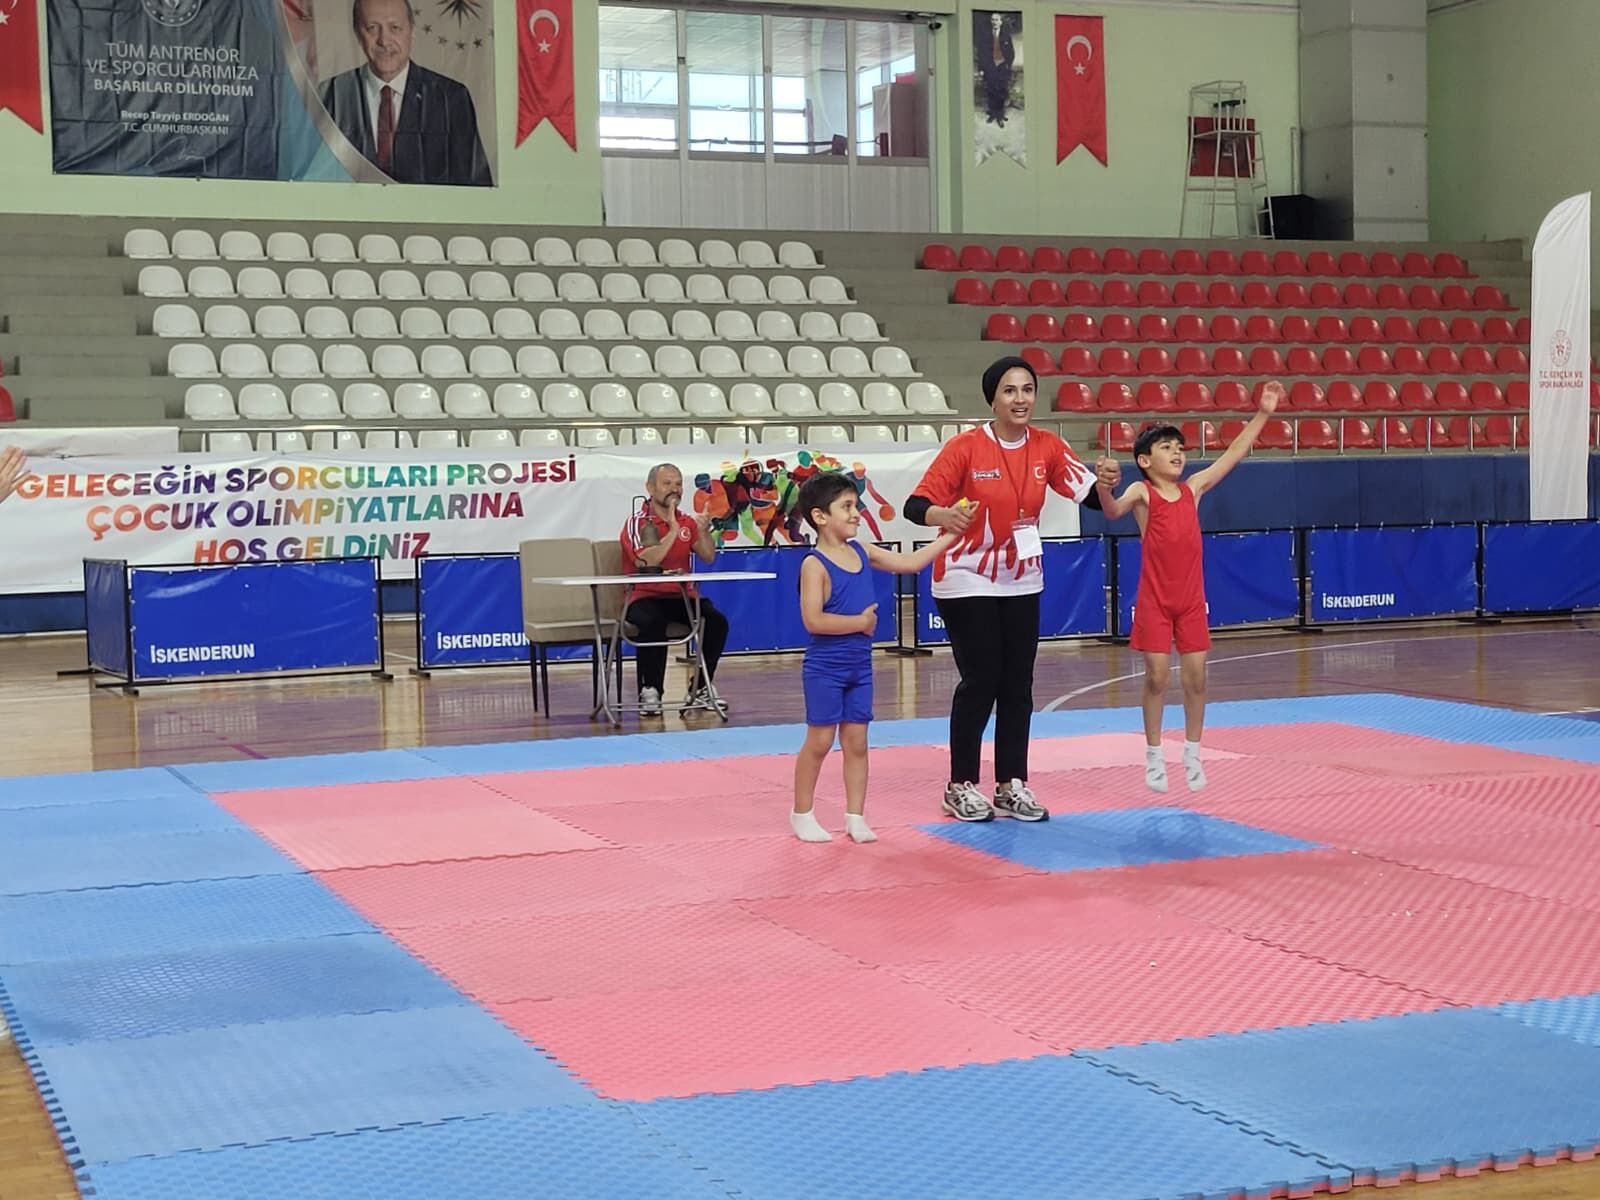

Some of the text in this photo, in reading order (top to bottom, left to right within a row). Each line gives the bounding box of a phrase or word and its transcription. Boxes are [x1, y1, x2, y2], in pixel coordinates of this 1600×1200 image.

[105, 41, 240, 63] TÜM ANTRENÖR
[86, 59, 259, 81] VE SPORCULARIMIZA
[94, 79, 254, 97] BAŞARILAR DİLİYORUM
[121, 110, 229, 122] Recep Tayyip ERDOĞAN
[142, 122, 229, 136] CUMHURBAŞKANI
[225, 465, 437, 493] SPORCULARI
[447, 454, 576, 487] PROJESİ
[86, 501, 218, 541] ÇOCUK
[1322, 592, 1395, 609] İSKENDERUN
[150, 643, 255, 664] İSKENDERUN
